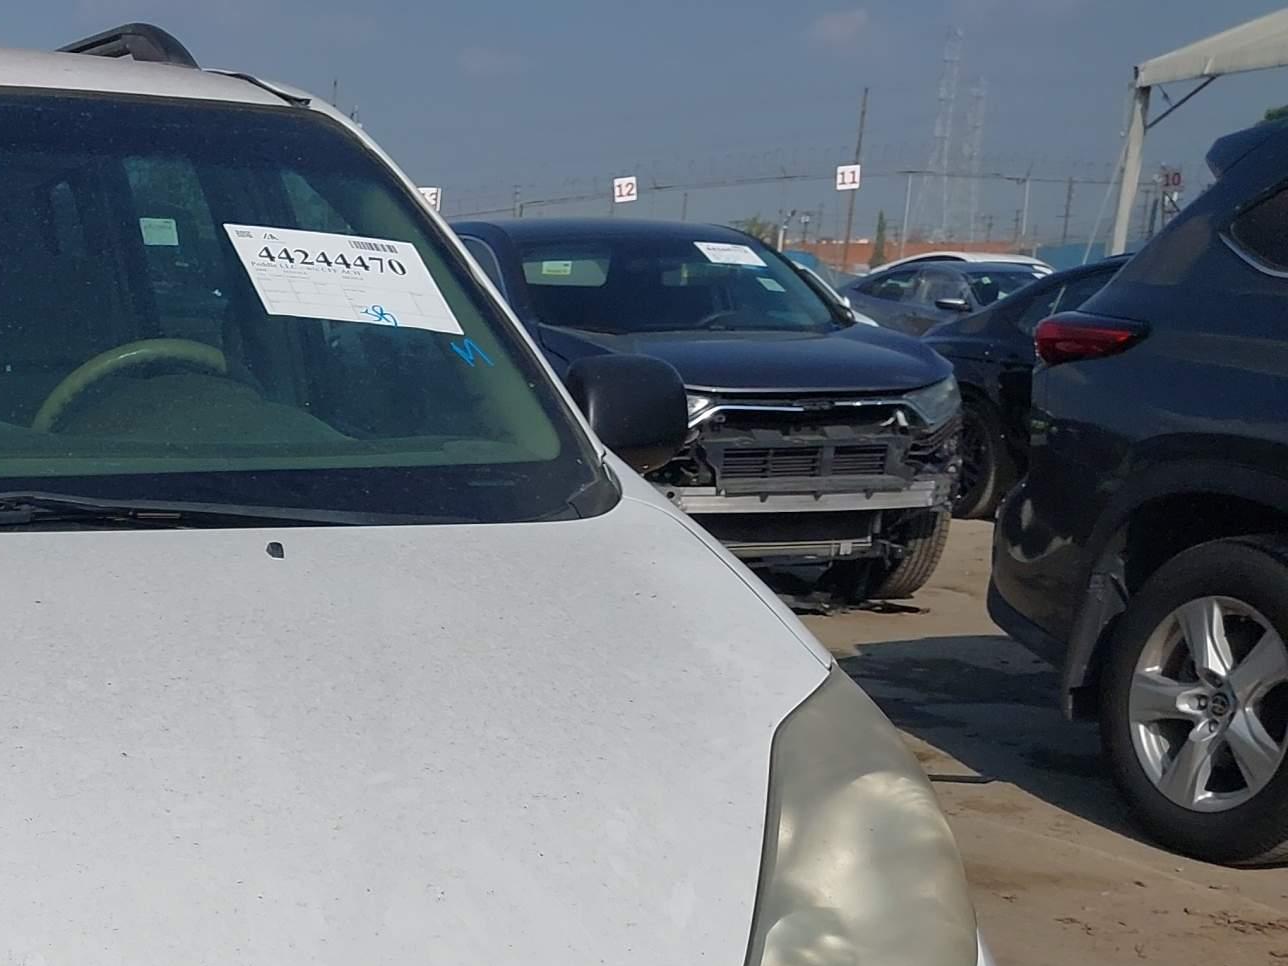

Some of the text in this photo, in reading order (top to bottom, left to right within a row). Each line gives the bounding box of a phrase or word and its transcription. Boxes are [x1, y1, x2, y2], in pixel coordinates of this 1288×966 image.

[839, 170, 857, 185] 11
[1163, 172, 1181, 187] 10
[616, 182, 635, 198] 12
[258, 246, 406, 276] 44244470
